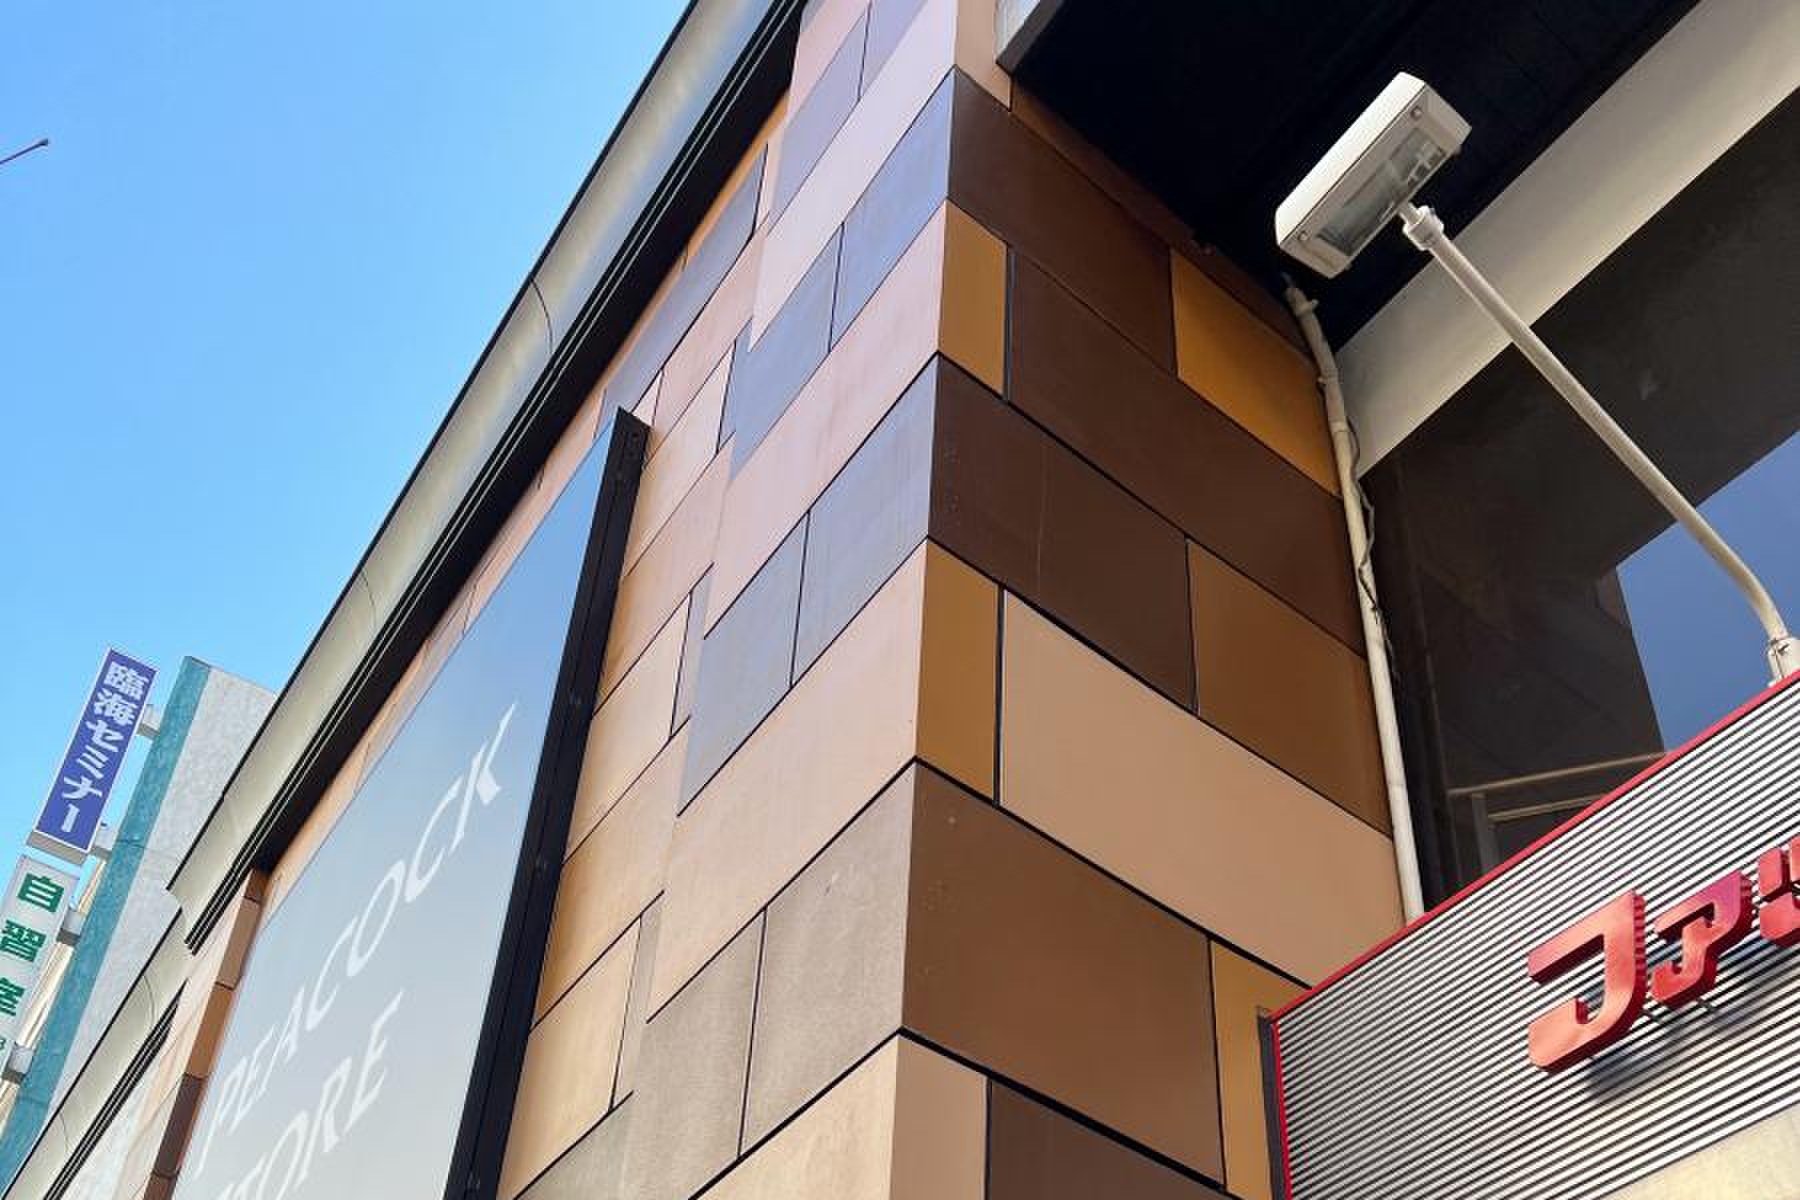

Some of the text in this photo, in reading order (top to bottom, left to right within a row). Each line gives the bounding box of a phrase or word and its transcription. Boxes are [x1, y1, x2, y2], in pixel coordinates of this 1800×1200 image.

[62, 661, 150, 833] 臨海セミナー
[194, 703, 515, 1174] PEACOCK
